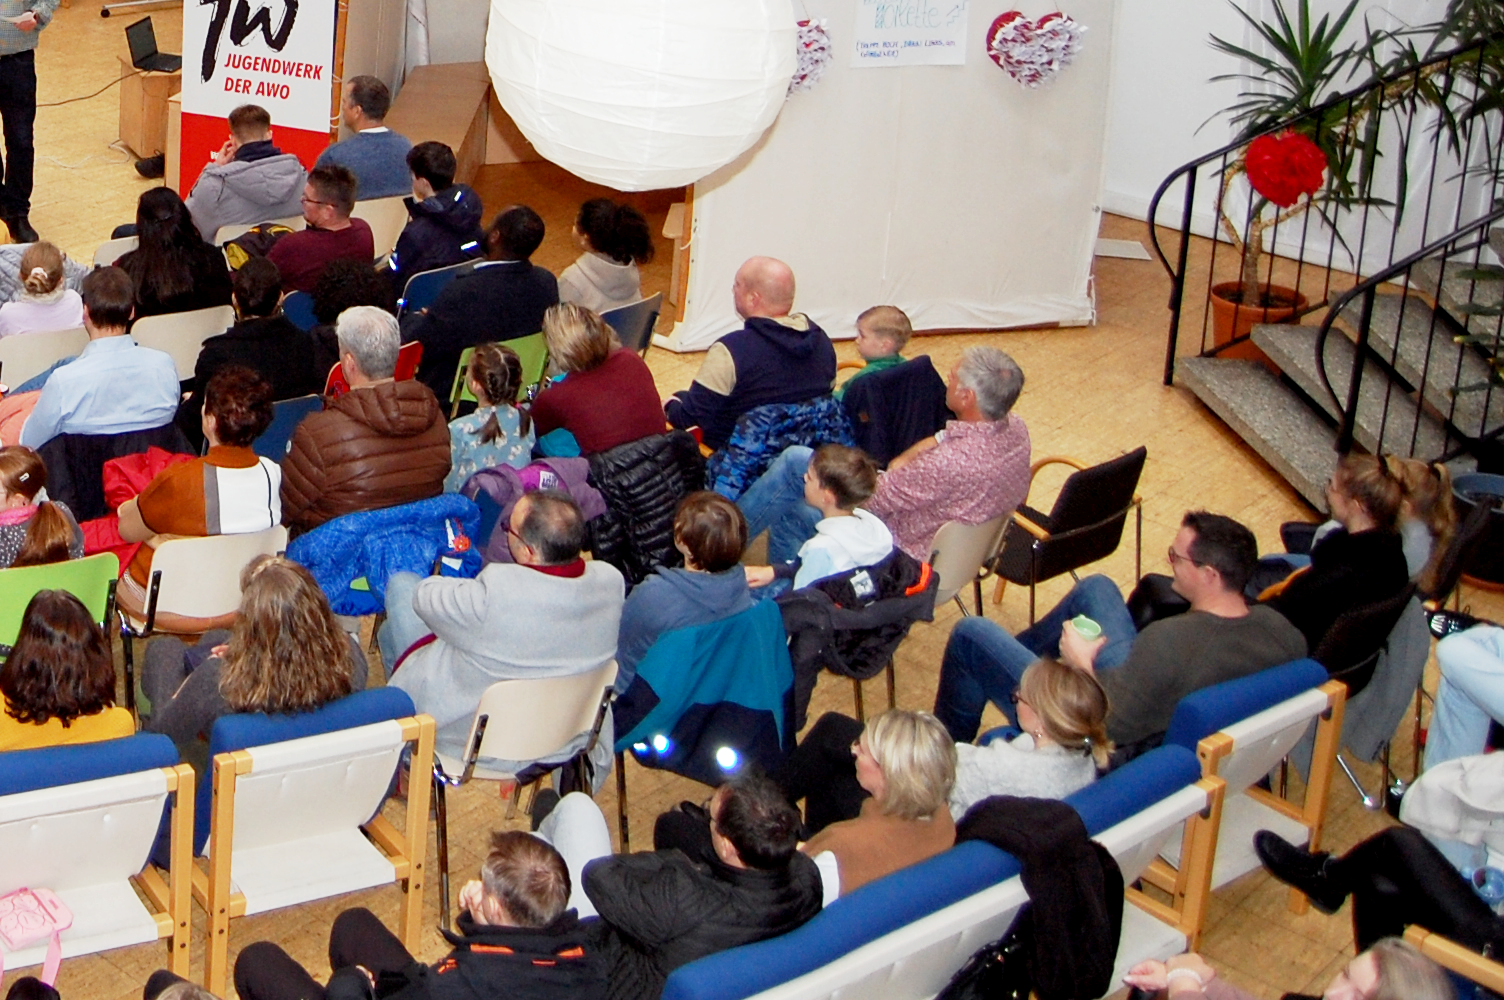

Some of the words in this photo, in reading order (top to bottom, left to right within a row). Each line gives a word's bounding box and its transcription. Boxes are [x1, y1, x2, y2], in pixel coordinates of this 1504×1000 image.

[224, 53, 323, 81] JUGENDWERK
[223, 77, 252, 95] DER
[255, 81, 290, 100] AWO
